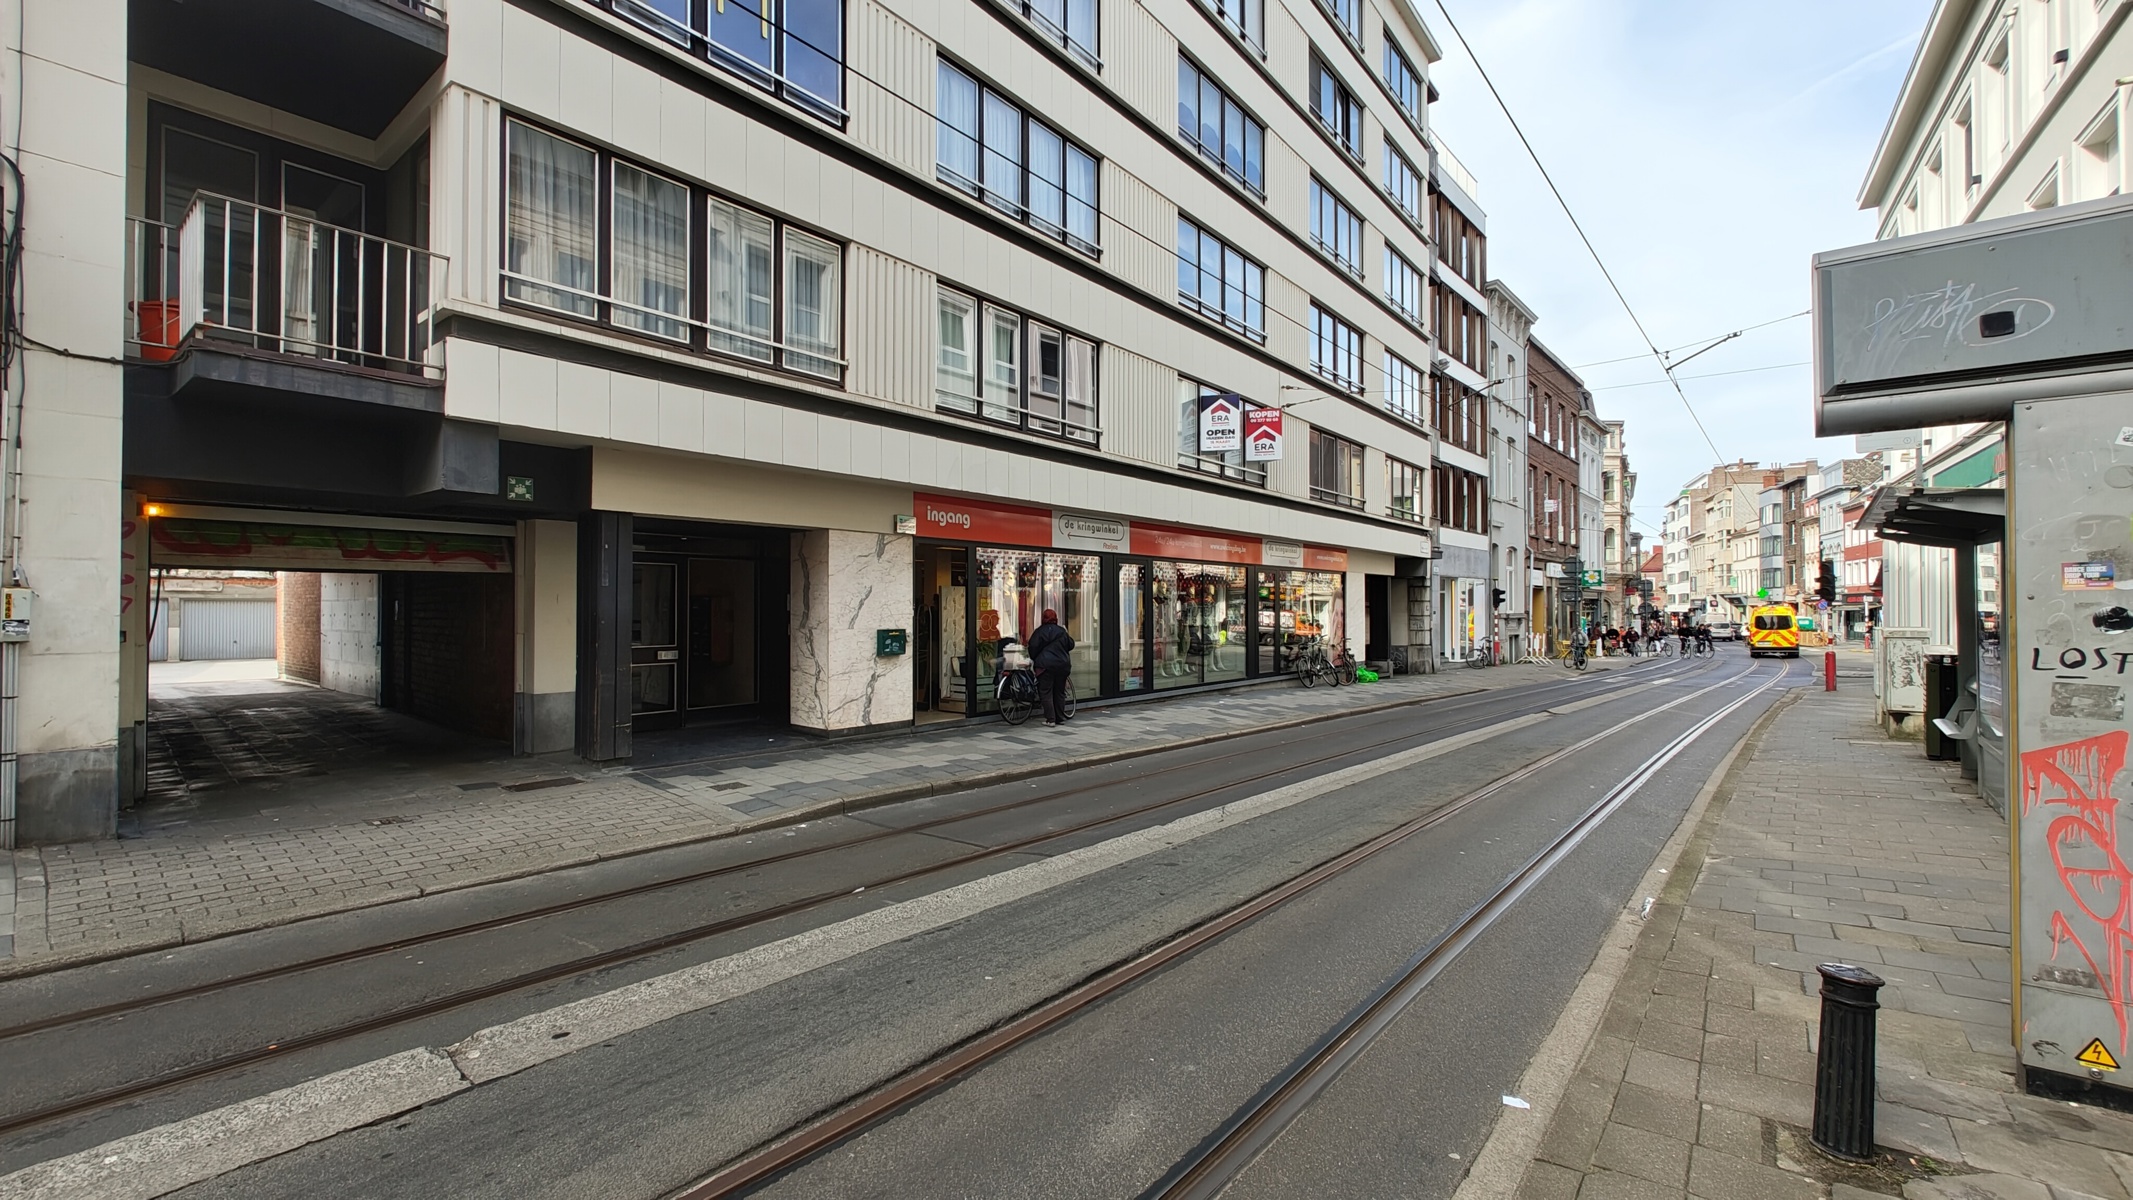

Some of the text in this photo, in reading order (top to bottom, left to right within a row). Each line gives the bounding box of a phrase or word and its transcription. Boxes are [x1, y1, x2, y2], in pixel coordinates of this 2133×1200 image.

[1249, 410, 1279, 418] KOPEN
[1254, 443, 1274, 451] ERA
[927, 505, 971, 529] ingang
[1064, 519, 1119, 535] de kringwinkel
[2086, 565, 2107, 573] DANCE
[2032, 647, 2133, 675] LOST
